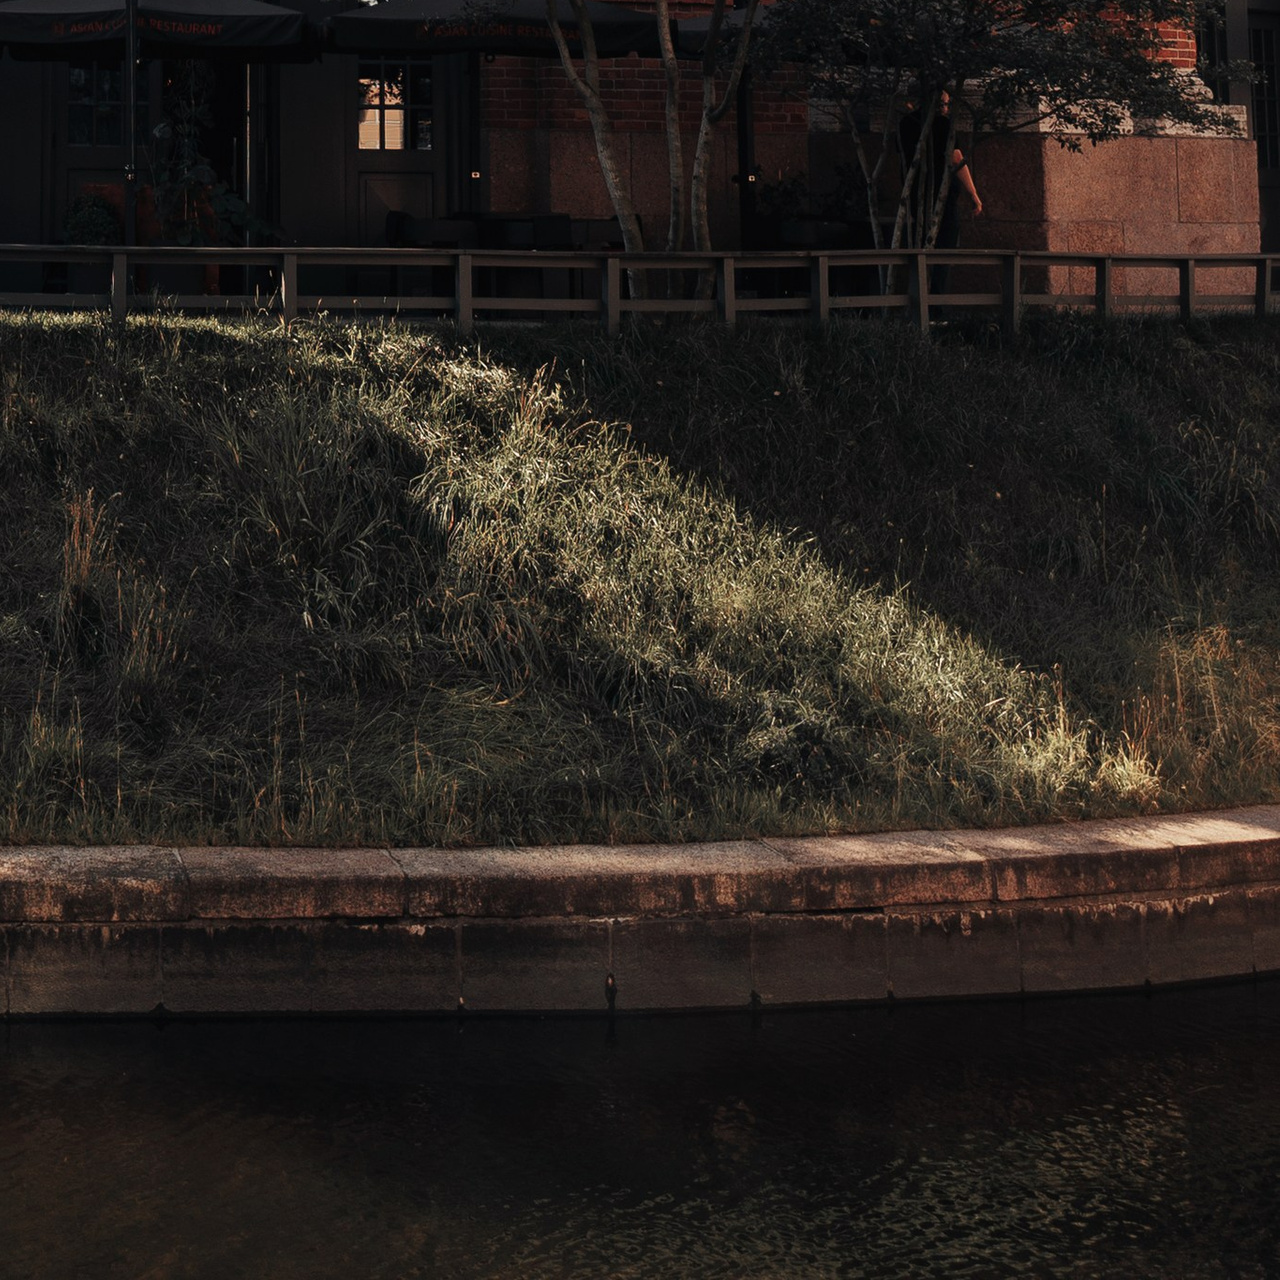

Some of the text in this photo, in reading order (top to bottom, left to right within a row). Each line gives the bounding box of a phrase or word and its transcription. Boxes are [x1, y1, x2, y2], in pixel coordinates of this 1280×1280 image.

[70, 21, 103, 34] ASIAN
[150, 18, 223, 35] RESTAURANT
[433, 24, 468, 37] ASIAN
